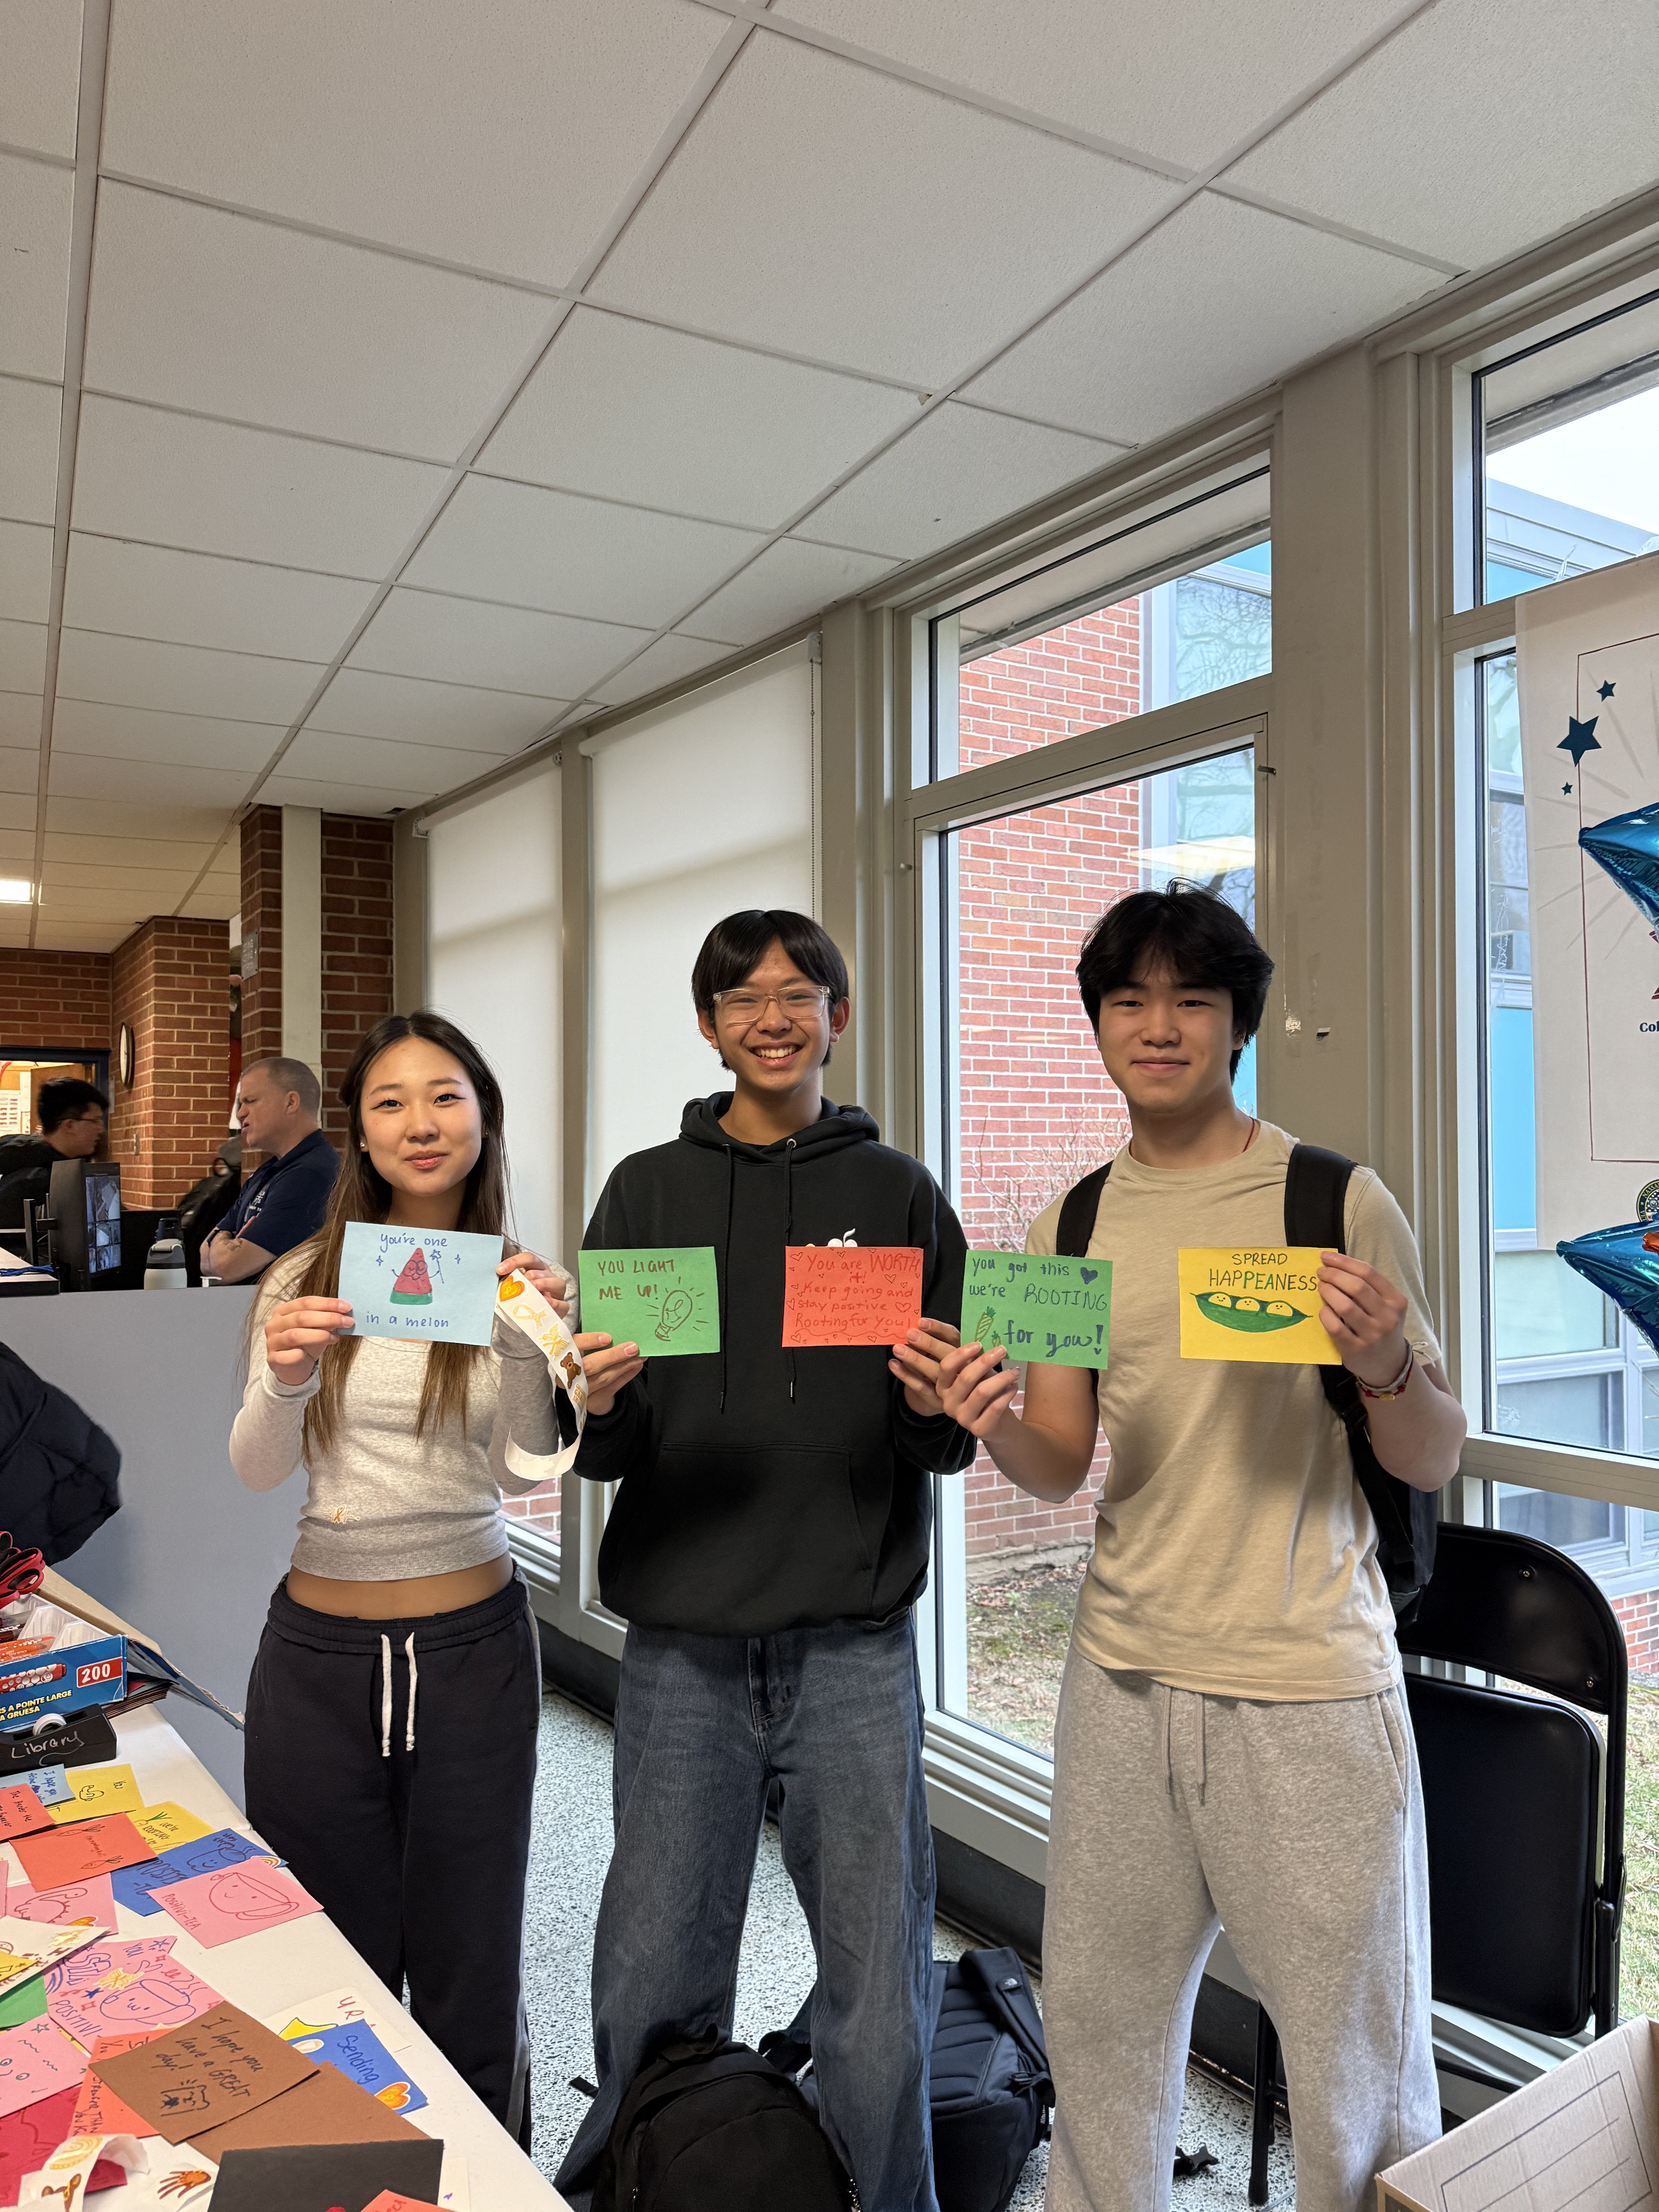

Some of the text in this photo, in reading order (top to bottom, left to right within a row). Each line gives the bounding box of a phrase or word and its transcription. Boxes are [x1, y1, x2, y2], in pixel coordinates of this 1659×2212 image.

[380, 1233, 448, 1252] you're one
[598, 1259, 674, 1276] YOU LIGHT
[807, 1253, 921, 1273] You are WORTH
[1232, 1252, 1288, 1266] SPREAD
[849, 1271, 866, 1284] it!
[972, 1258, 1070, 1283] you got this
[1209, 1268, 1317, 1291] HAPPEANESS
[599, 1284, 659, 1300] ME UP!
[803, 1281, 913, 1300] Keep going and
[969, 1283, 1107, 1311] we're ROOTING
[798, 1300, 888, 1312] stay positive
[366, 1312, 448, 1327] in a melon
[795, 1313, 848, 1331] Rooting
[848, 1313, 867, 1326] for
[1004, 1319, 1104, 1357] for you!
[81, 1664, 110, 1683] 200
[16, 1697, 45, 1710] POINTE
[46, 1690, 72, 1702] LARGE
[7, 1706, 40, 1719] GRUESA
[11, 1731, 84, 1766] Library
[201, 2017, 264, 2072] I hope you
[175, 2037, 208, 2058] have
[208, 2069, 251, 2097] GREAT
[337, 2035, 380, 2085] Sending
